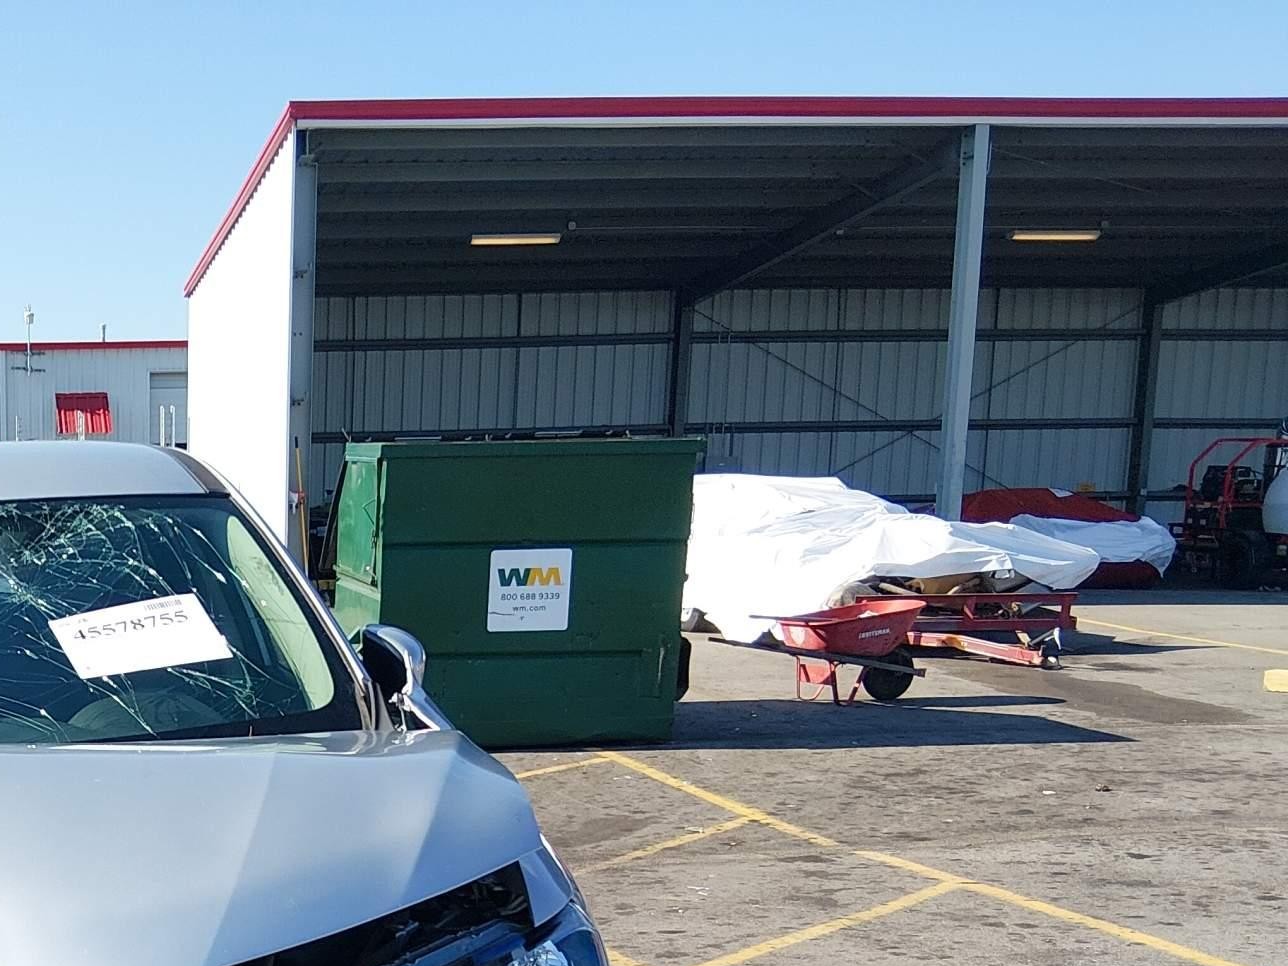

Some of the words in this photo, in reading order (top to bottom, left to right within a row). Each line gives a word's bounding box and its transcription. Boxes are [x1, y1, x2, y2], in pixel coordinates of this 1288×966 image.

[498, 567, 562, 587] WM
[501, 592, 518, 601] 800
[538, 592, 560, 600] 9339
[74, 610, 189, 640] 45578755
